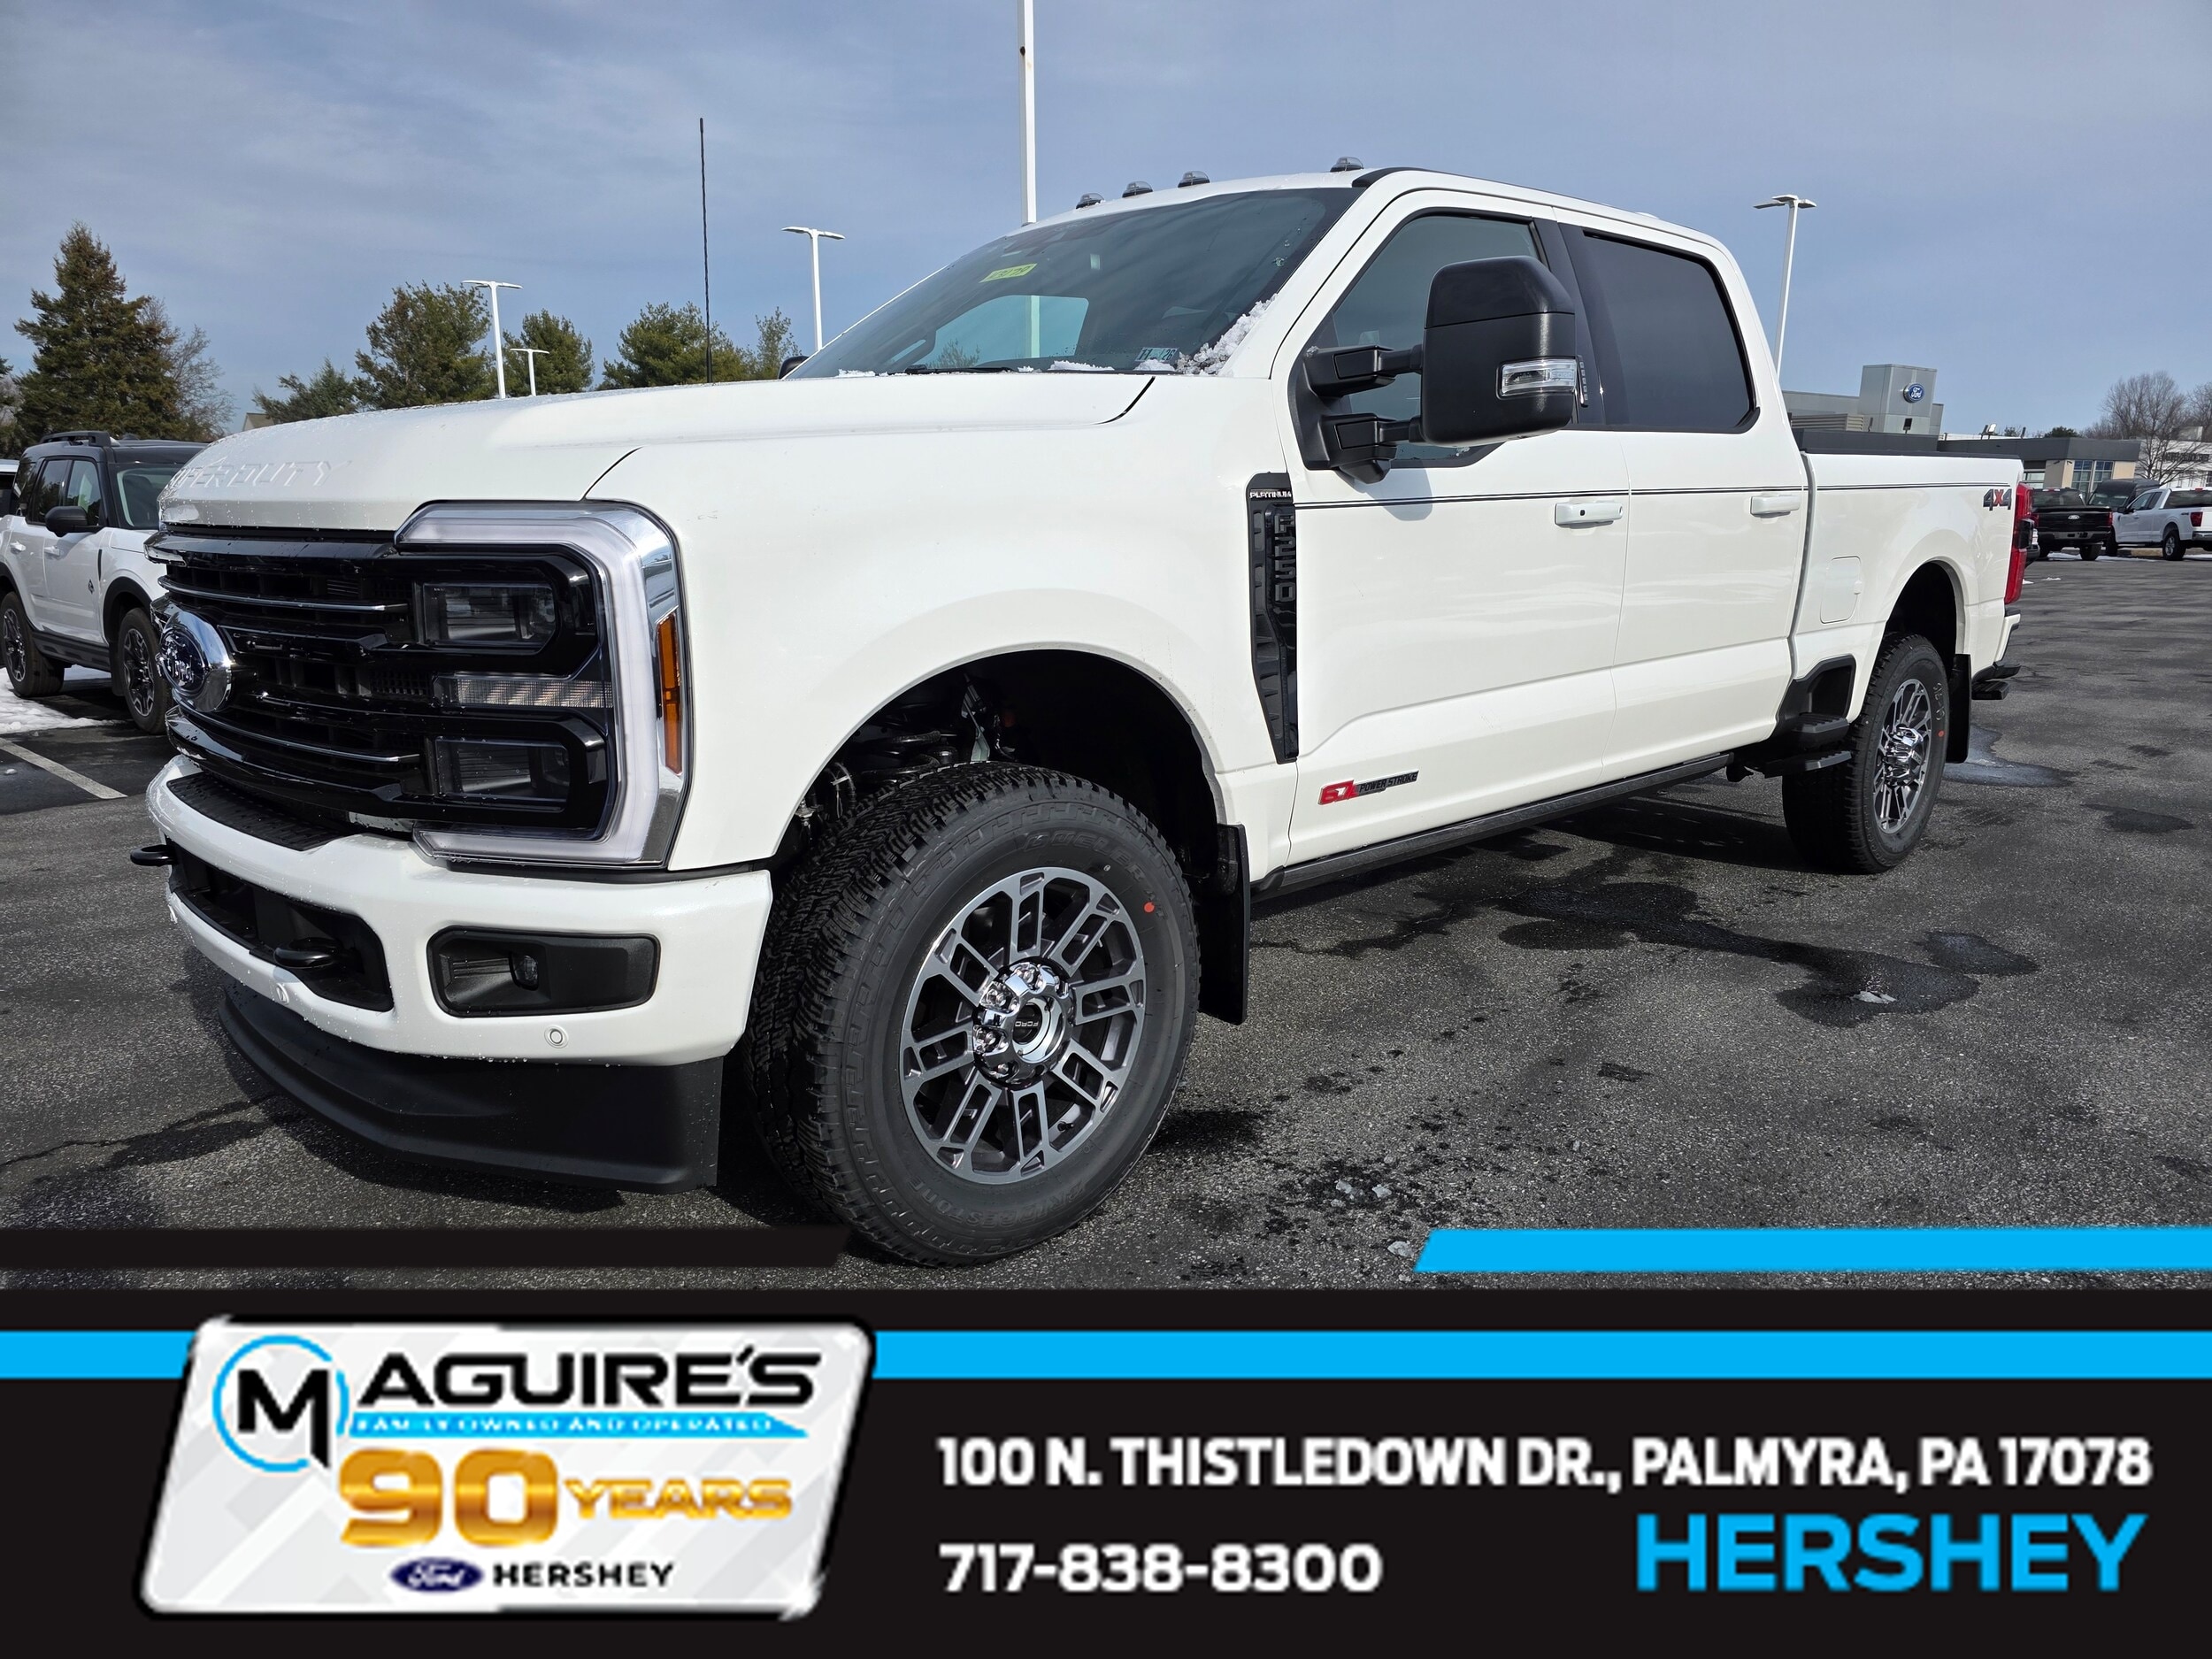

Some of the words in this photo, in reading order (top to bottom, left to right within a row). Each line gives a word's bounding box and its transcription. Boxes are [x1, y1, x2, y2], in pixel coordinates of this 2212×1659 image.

[1249, 490, 1292, 499] PLATINUM
[1359, 779, 1386, 795] POWER
[1387, 772, 1418, 787] STROKE
